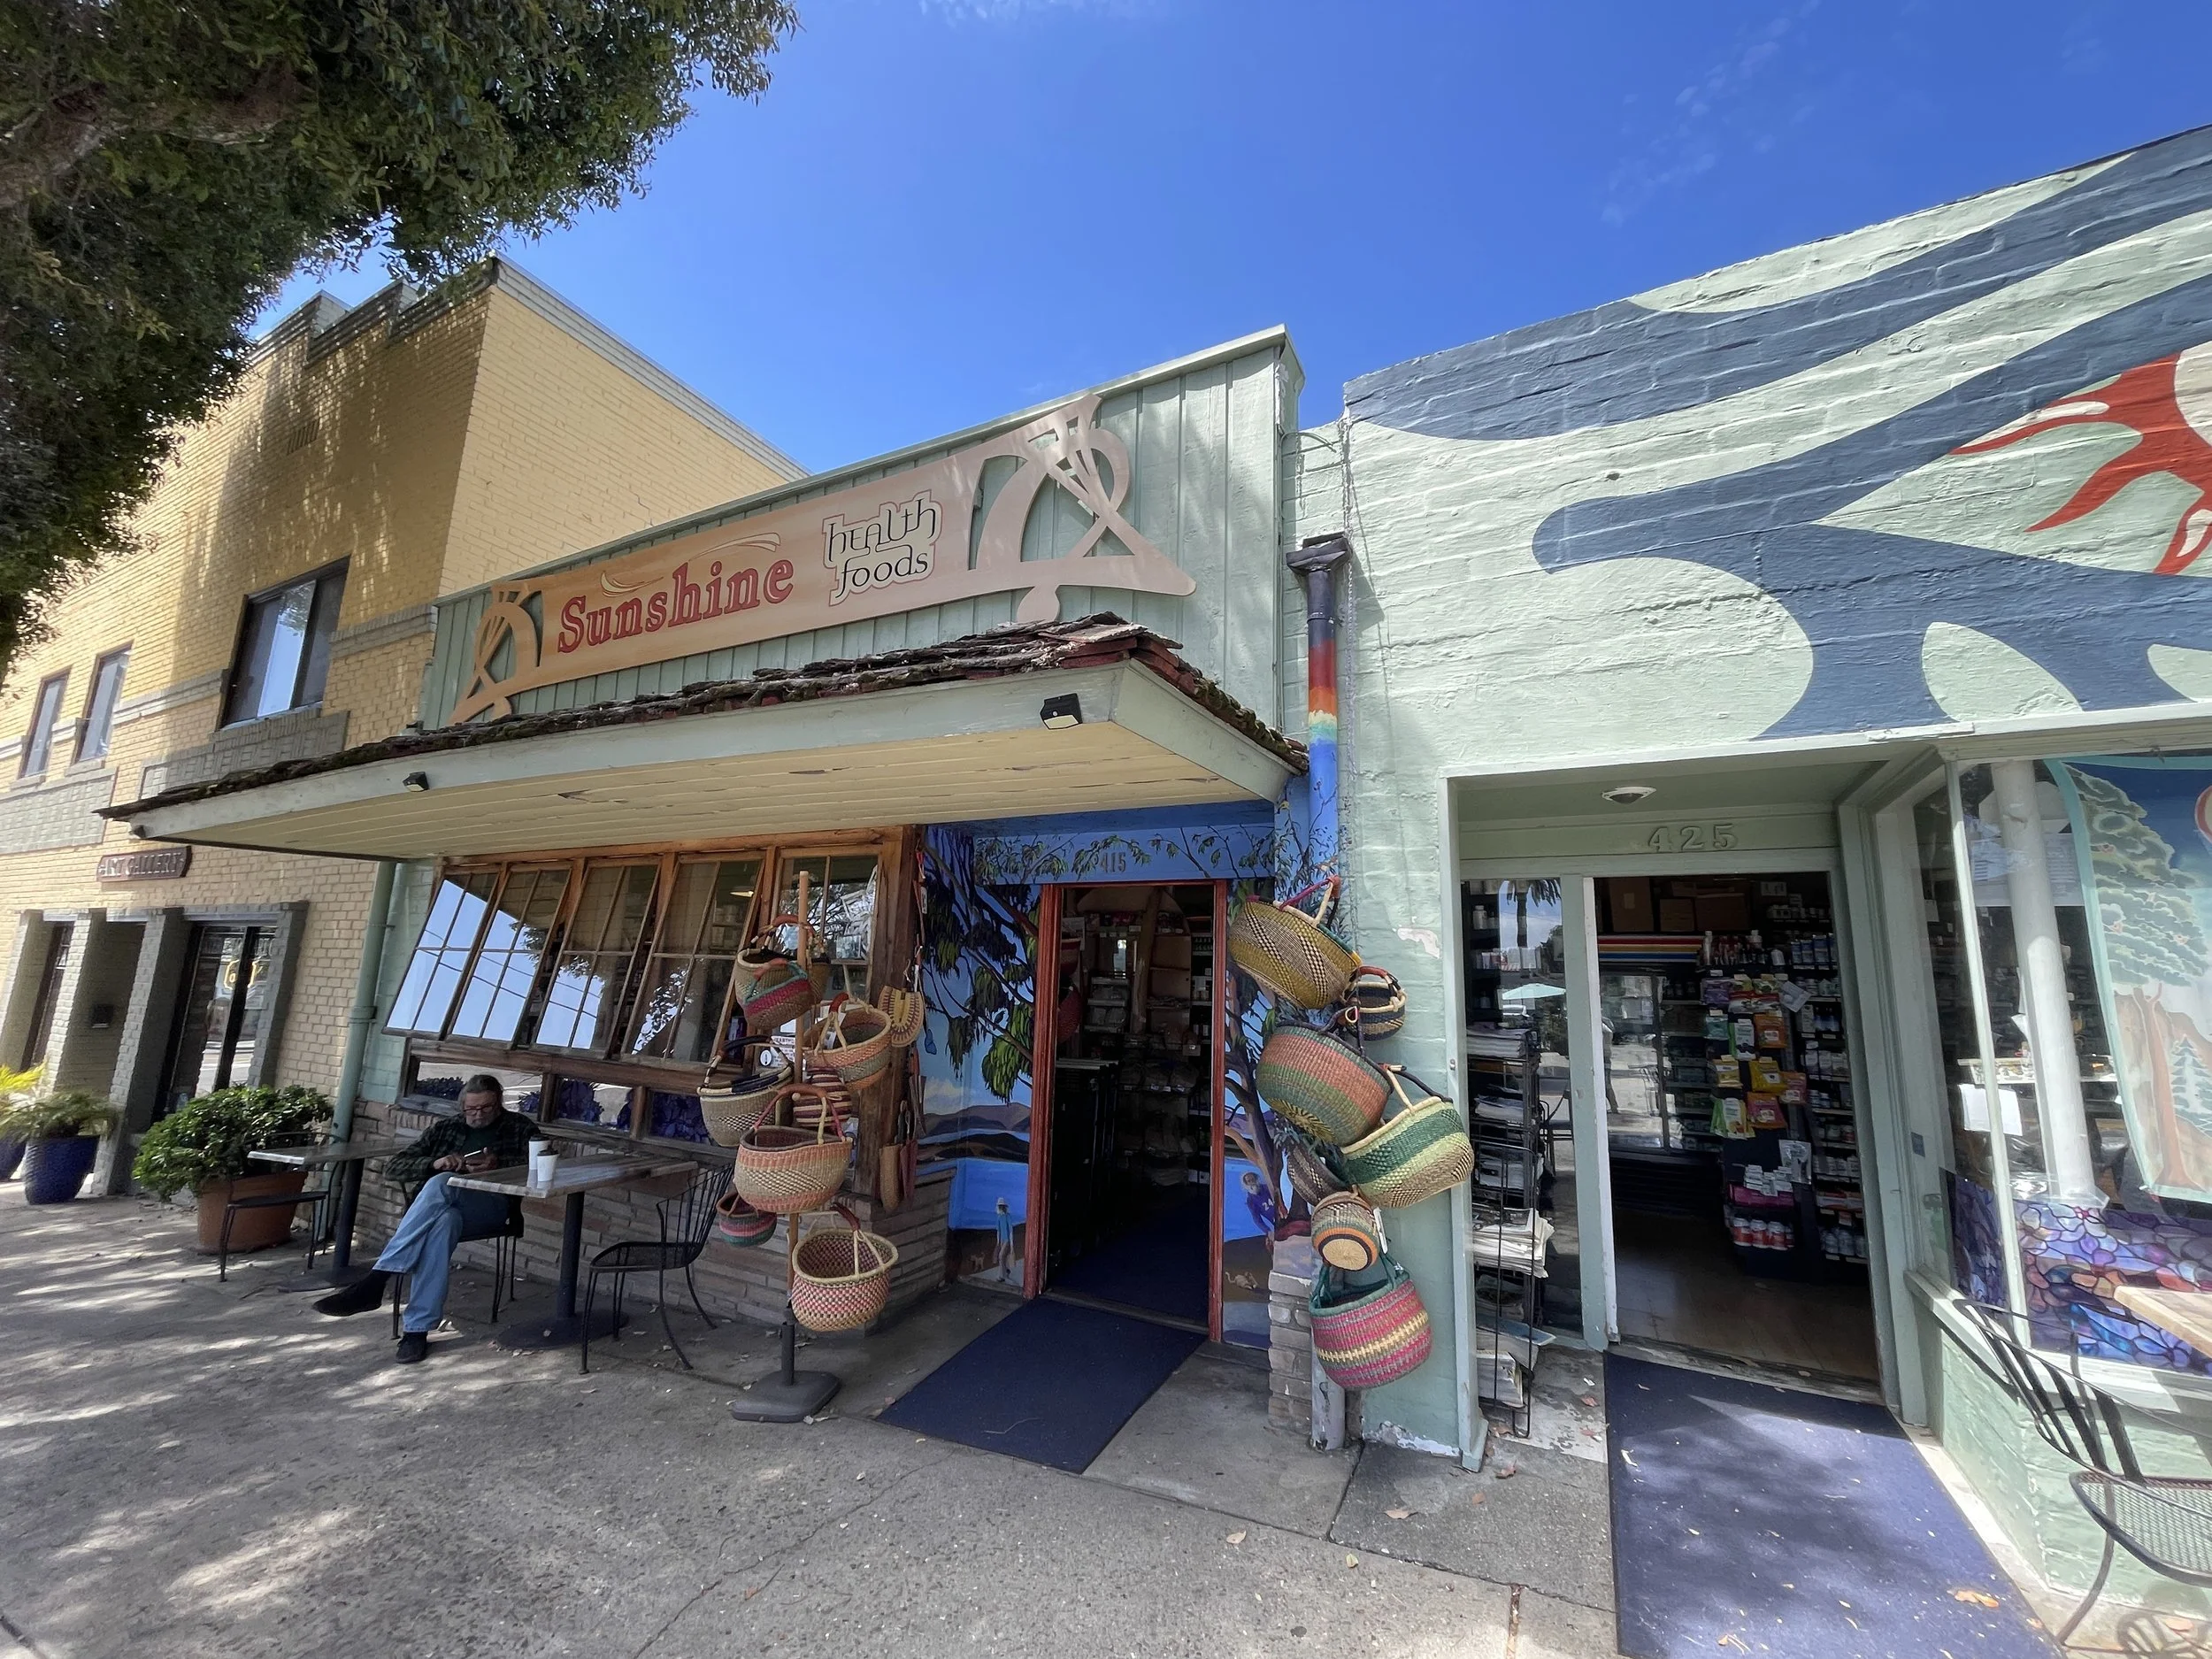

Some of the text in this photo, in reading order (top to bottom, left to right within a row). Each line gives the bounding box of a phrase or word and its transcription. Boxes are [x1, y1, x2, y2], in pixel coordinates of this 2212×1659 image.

[835, 543, 928, 599] foods
[557, 559, 795, 654] Sunshine
[1647, 822, 1739, 853] 425
[125, 852, 181, 875] GALLERY
[1100, 851, 1126, 873] 415
